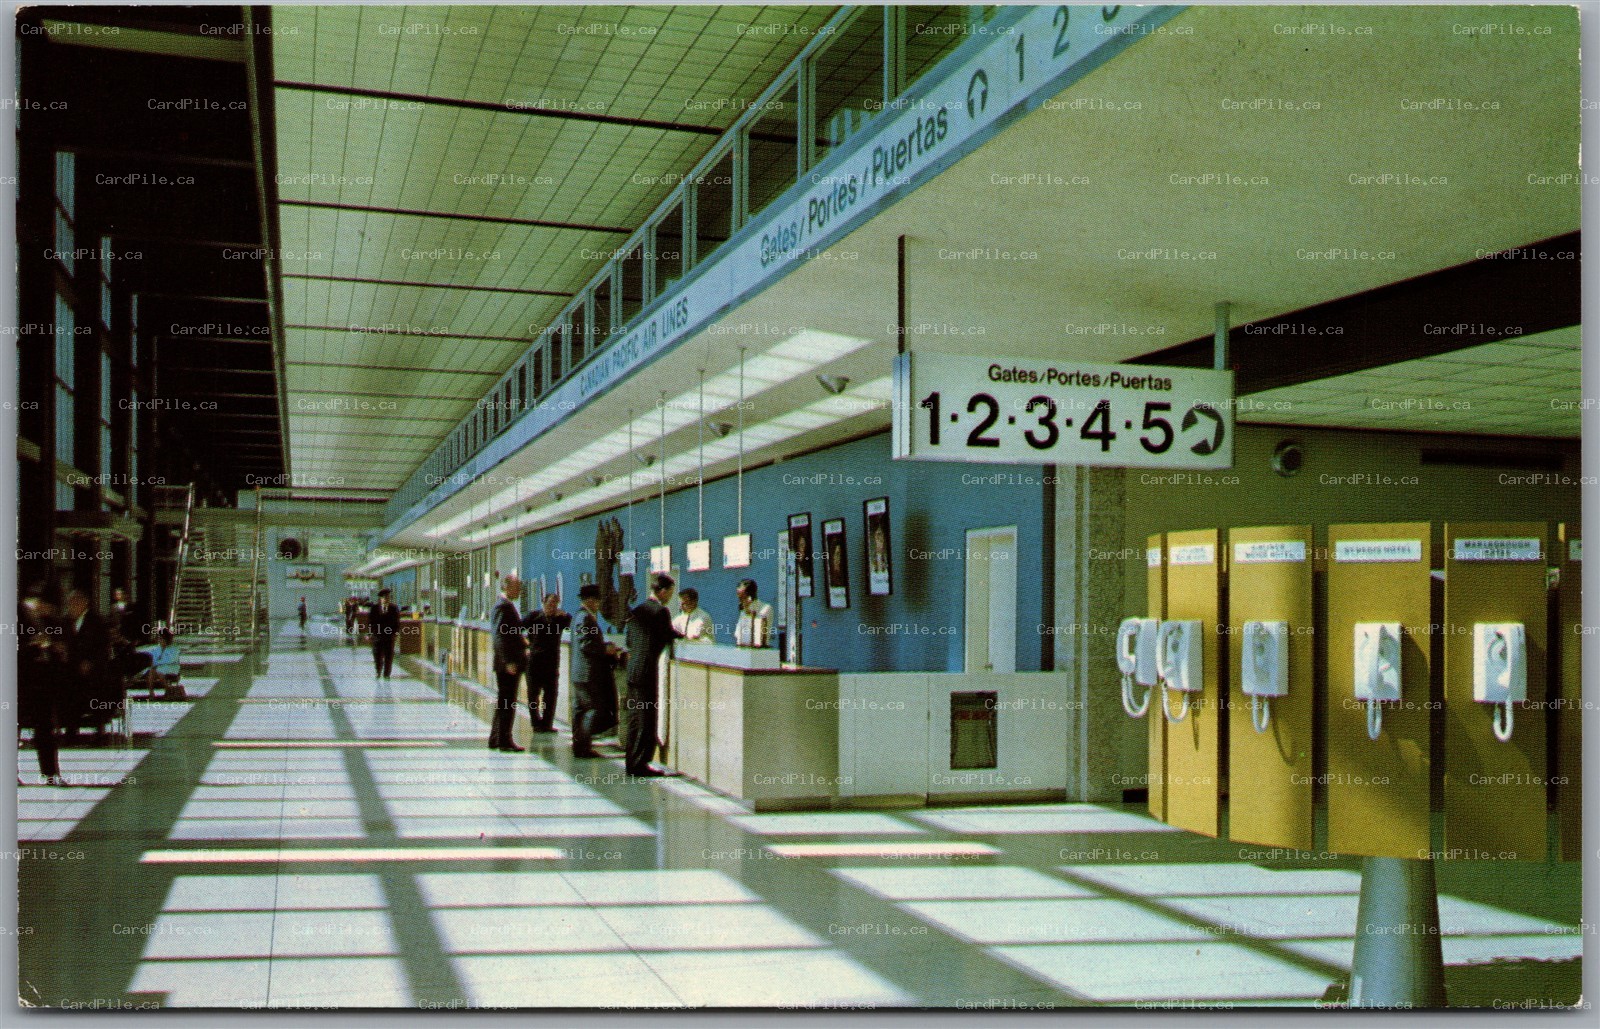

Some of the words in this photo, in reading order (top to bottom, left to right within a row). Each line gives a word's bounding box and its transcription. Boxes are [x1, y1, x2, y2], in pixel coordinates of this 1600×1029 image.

[1015, 33, 1025, 82] 1
[1052, 5, 1070, 59] 2
[580, 358, 609, 397] CANADIAN
[612, 333, 638, 372] PACIFIC
[643, 320, 657, 351] AIR
[662, 296, 688, 338] LINES
